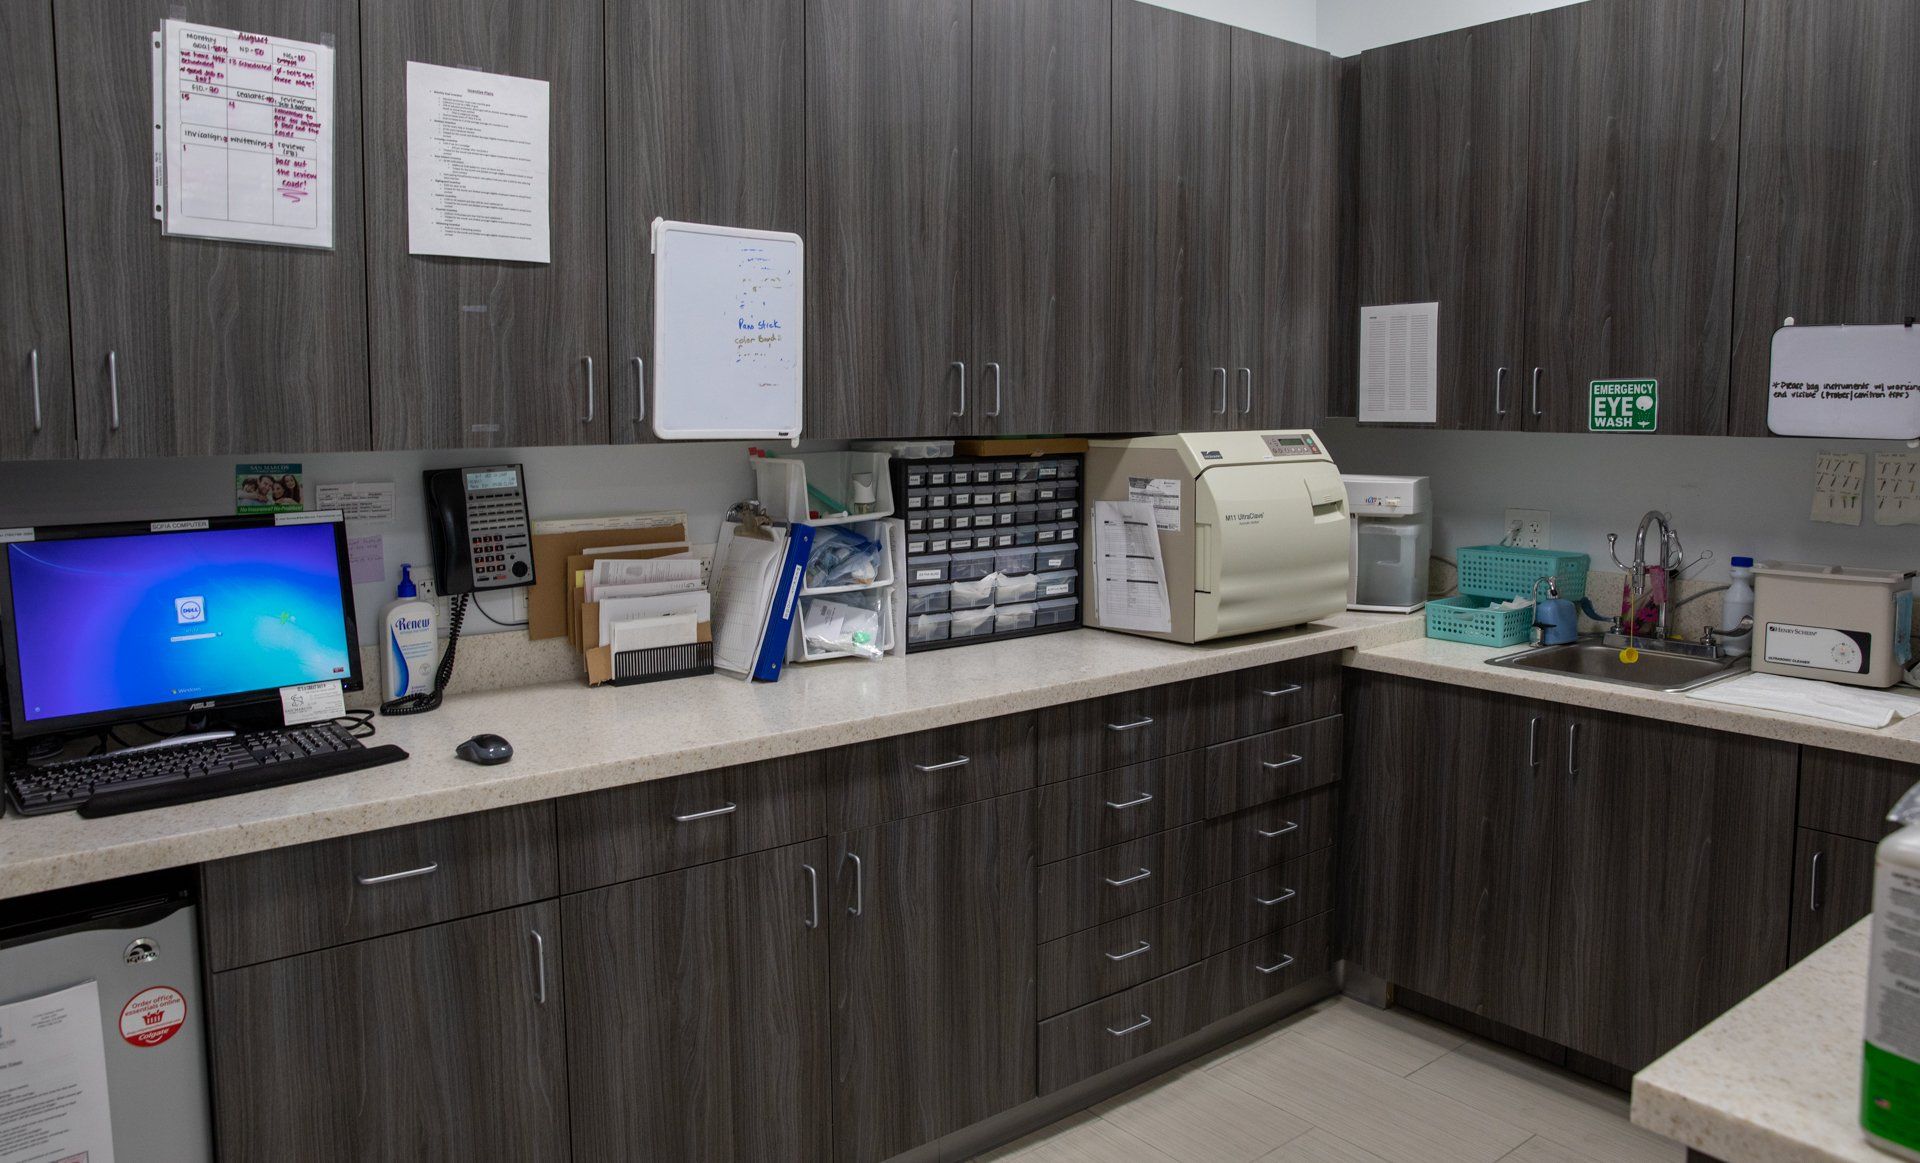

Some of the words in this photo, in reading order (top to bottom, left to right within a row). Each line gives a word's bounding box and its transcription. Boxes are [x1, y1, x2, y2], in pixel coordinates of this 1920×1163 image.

[238, 33, 268, 44] August
[1594, 384, 1654, 395] EMERGENCY
[1806, 382, 1819, 392] bag
[1594, 397, 1633, 416] EYE
[1594, 417, 1632, 428] WASH
[172, 521, 207, 529] COMPUTER
[395, 617, 430, 631] Renew
[190, 701, 216, 710] ASUS
[125, 1004, 158, 1016] essentials
[160, 998, 180, 1008] online
[132, 1000, 152, 1009] Order
[153, 994, 173, 1004] office
[138, 1028, 169, 1041] Colgate
